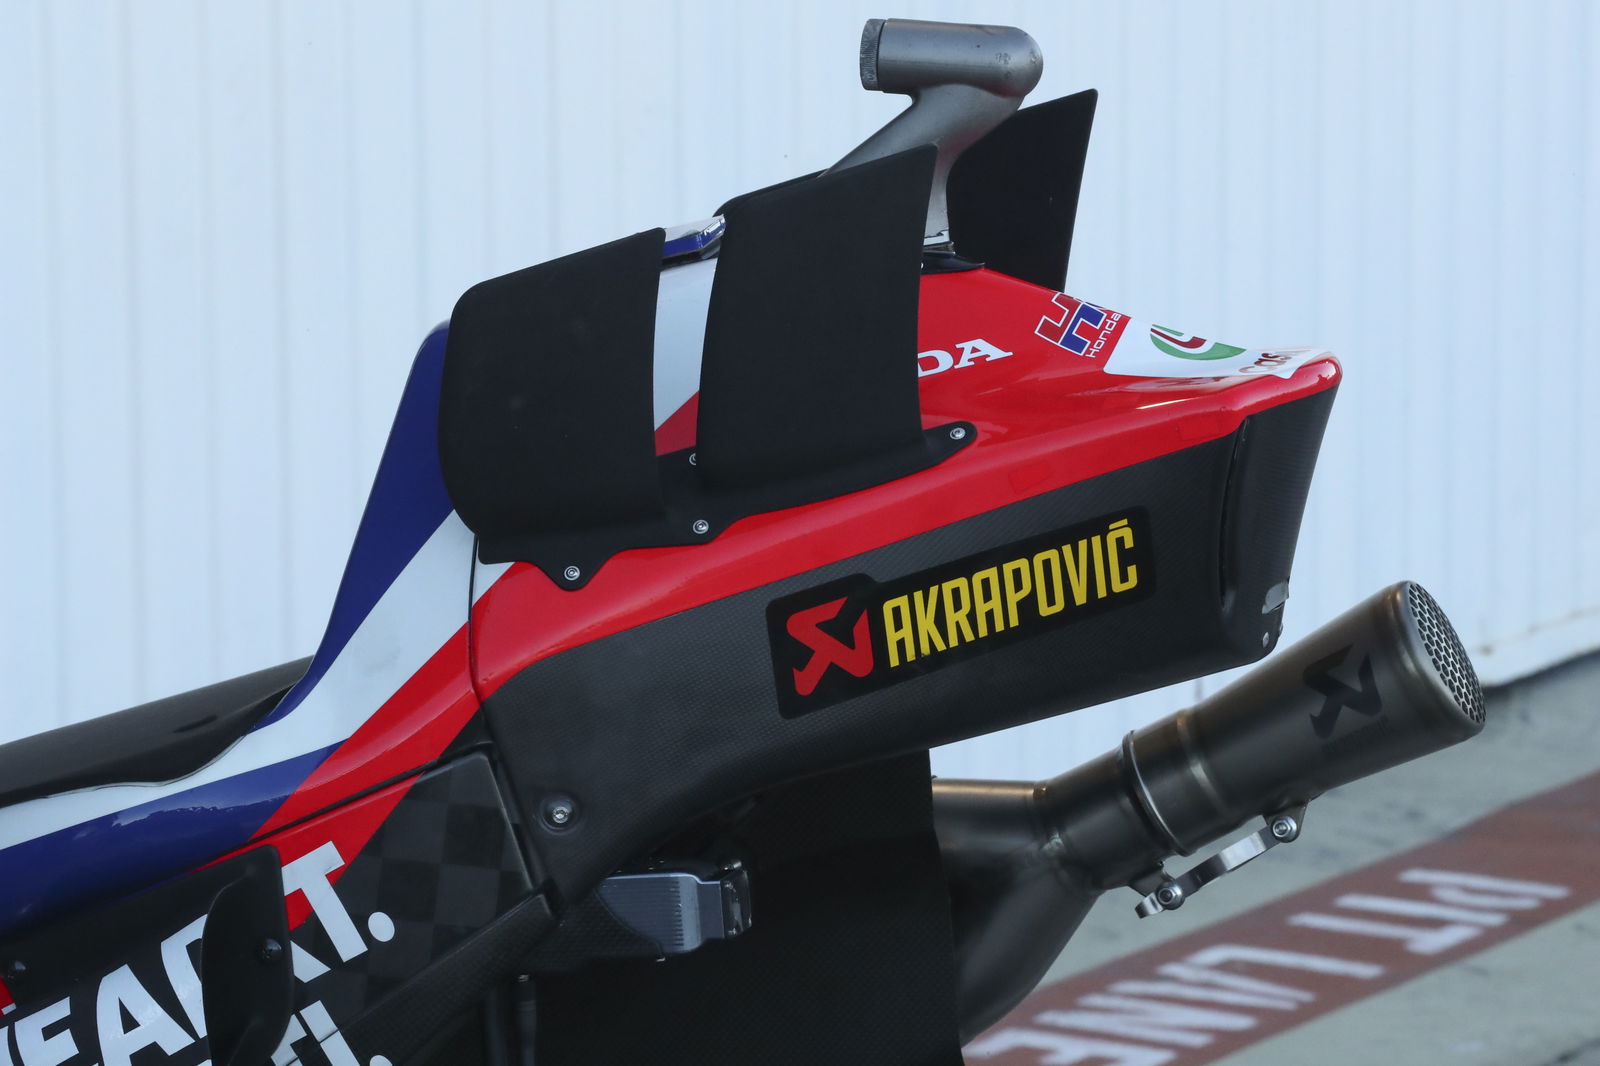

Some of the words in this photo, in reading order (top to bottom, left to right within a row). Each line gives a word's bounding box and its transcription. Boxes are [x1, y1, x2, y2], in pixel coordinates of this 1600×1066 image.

[1085, 312, 1122, 358] Honda
[1287, 868, 1572, 955] PIT
[963, 943, 1386, 1066] LANE
